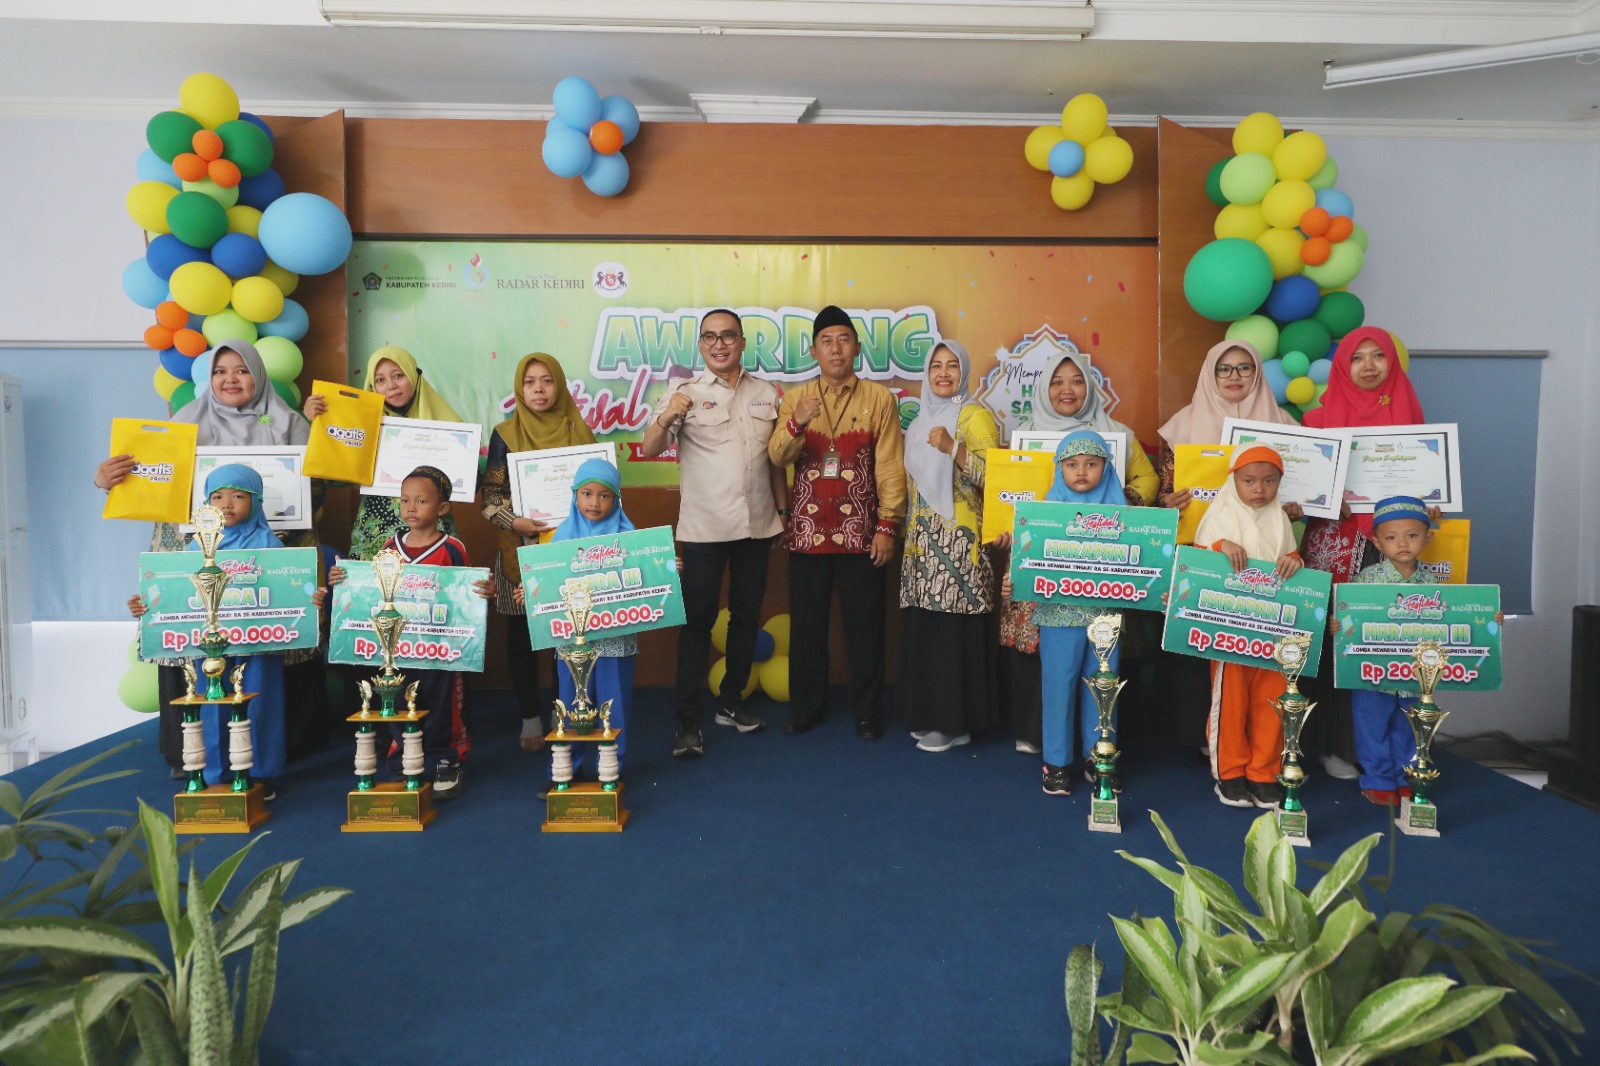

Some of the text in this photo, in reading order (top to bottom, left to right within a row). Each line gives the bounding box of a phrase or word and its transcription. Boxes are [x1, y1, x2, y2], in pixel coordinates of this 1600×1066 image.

[496, 279, 585, 289] RADAR KEDIRI
[599, 312, 934, 374] AWRDNG
[1083, 511, 1119, 533] Festival
[586, 539, 620, 562] Festival
[1045, 540, 1140, 564] HARAPAN I
[623, 568, 641, 588] III
[1035, 577, 1056, 597] Rp
[259, 588, 269, 606] I
[1199, 589, 1296, 625] HARAPAN II
[1403, 590, 1440, 614] Festival
[433, 604, 447, 623] II
[1184, 611, 1201, 619] LOMBA
[552, 619, 573, 637] Rp
[1363, 624, 1470, 644] HARAPAN III
[164, 631, 188, 650] Rp
[355, 638, 376, 658] Rp
[1189, 629, 1274, 658] Rp 250.00
[1362, 663, 1384, 682] Rp
